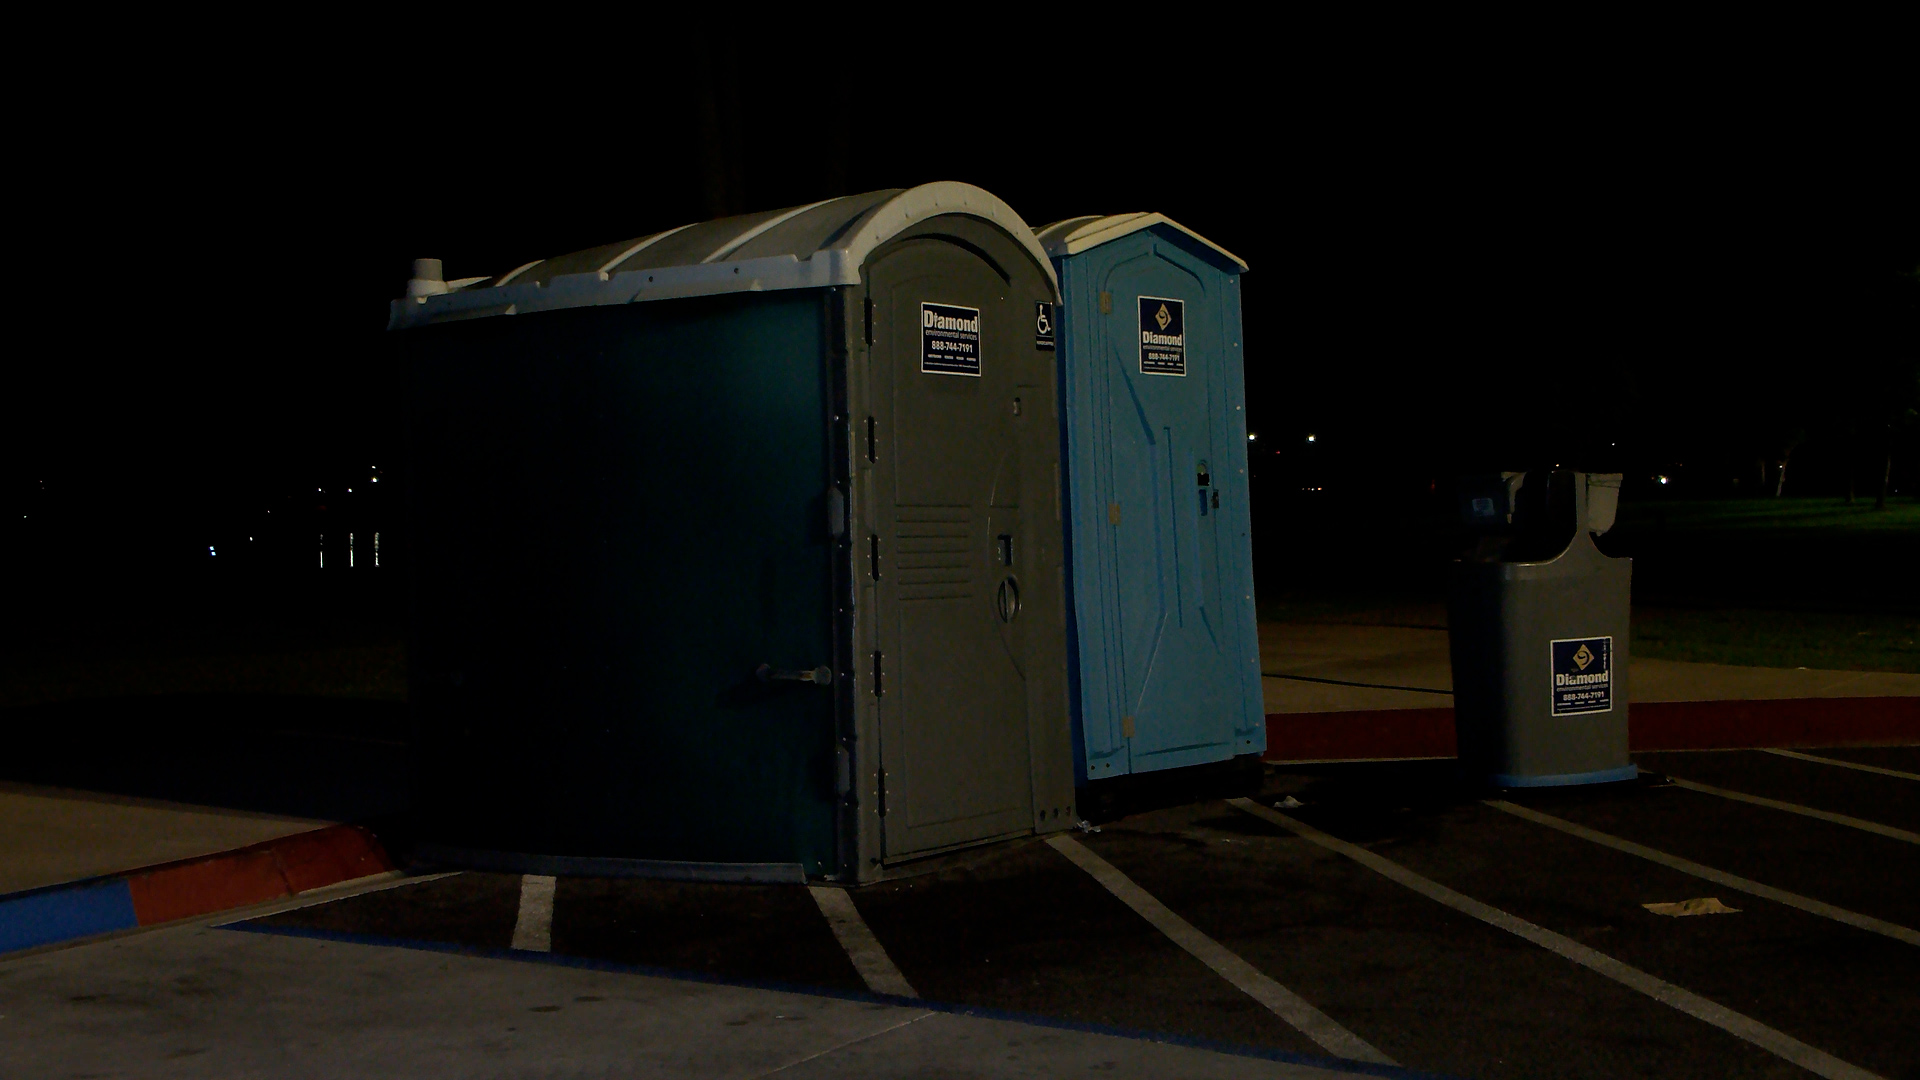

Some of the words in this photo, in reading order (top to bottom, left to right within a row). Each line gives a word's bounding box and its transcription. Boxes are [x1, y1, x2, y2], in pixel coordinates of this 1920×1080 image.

[924, 310, 978, 333] Diamond
[1142, 331, 1182, 346] Diamond
[1556, 670, 1608, 686] Diamond
